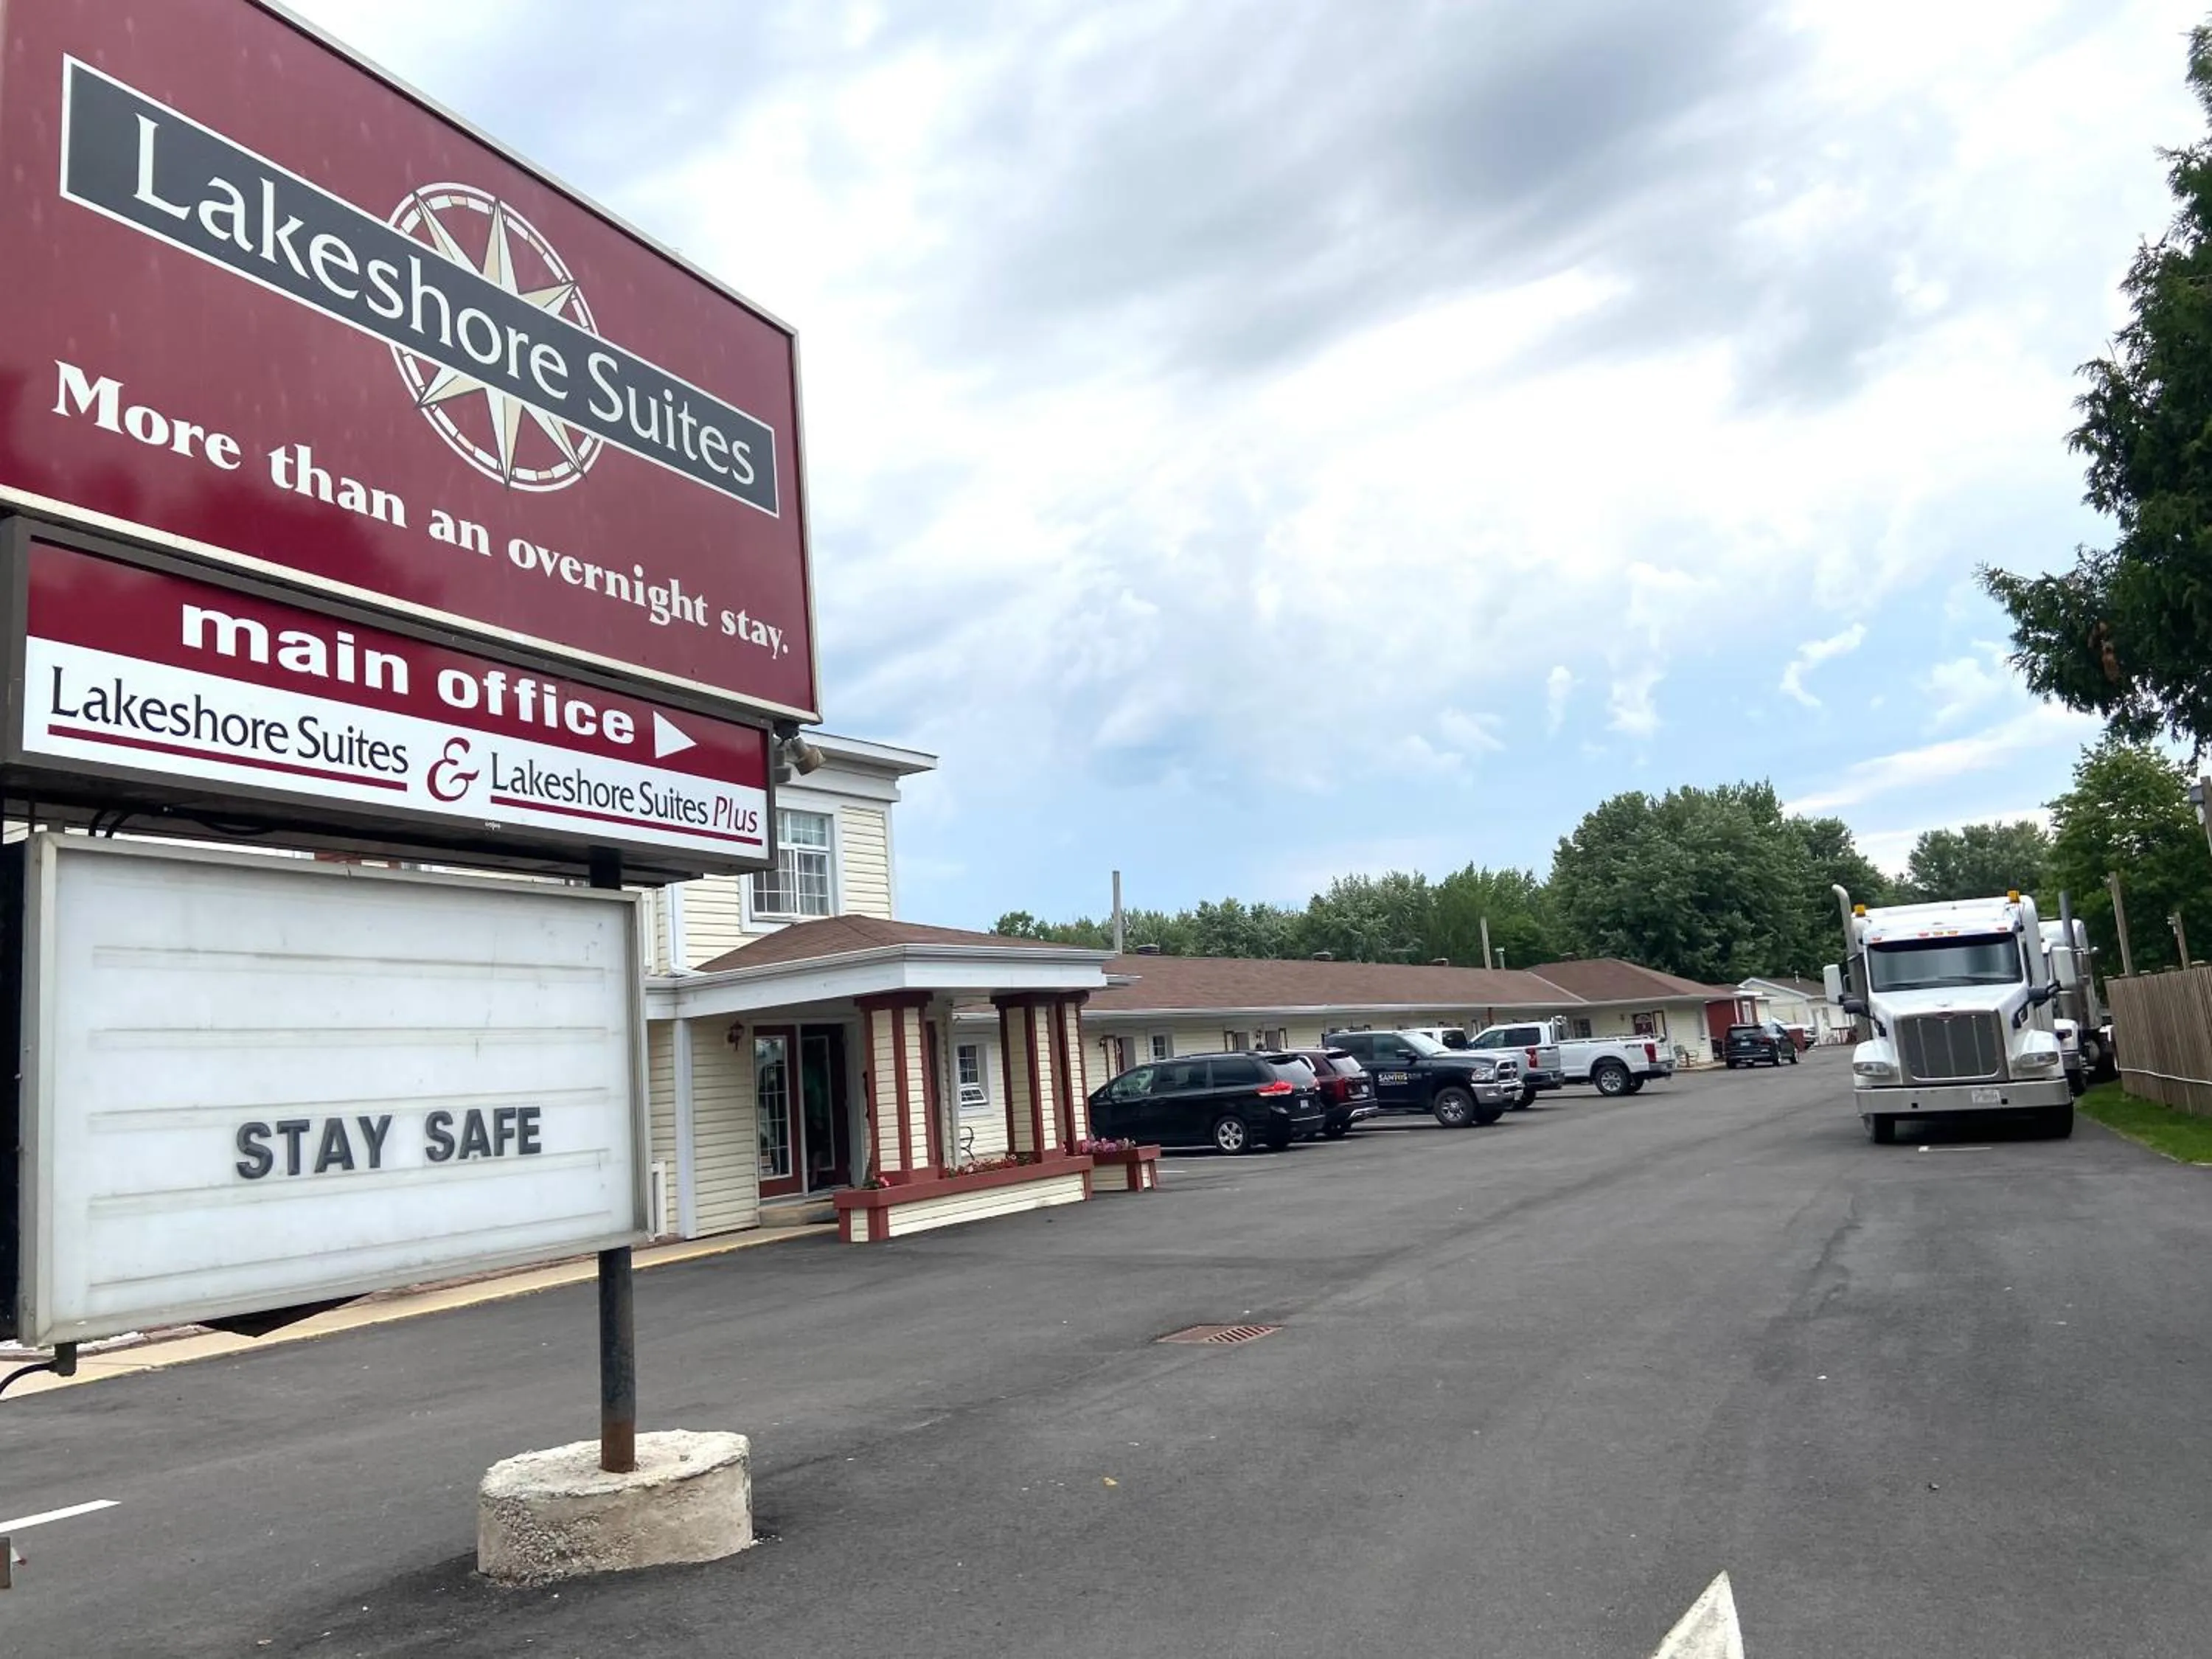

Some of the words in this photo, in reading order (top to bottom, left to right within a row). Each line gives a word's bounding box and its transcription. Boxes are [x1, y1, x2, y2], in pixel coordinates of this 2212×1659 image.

[133, 113, 569, 402] Lakeshore
[588, 352, 755, 487] Suites
[52, 359, 241, 470] More
[268, 444, 407, 528] than
[428, 509, 492, 557] an
[507, 538, 709, 627] overnight
[720, 609, 789, 659] stay.
[50, 666, 288, 754] Lakeshore
[297, 716, 409, 775] Suites
[427, 737, 480, 802] &
[491, 752, 635, 812] Lakeshore
[639, 781, 708, 825] Suites
[712, 796, 758, 833] Plus
[182, 604, 409, 695] main
[437, 668, 635, 745] office
[236, 1115, 392, 1180] STAY
[425, 1107, 541, 1162] SAFE
